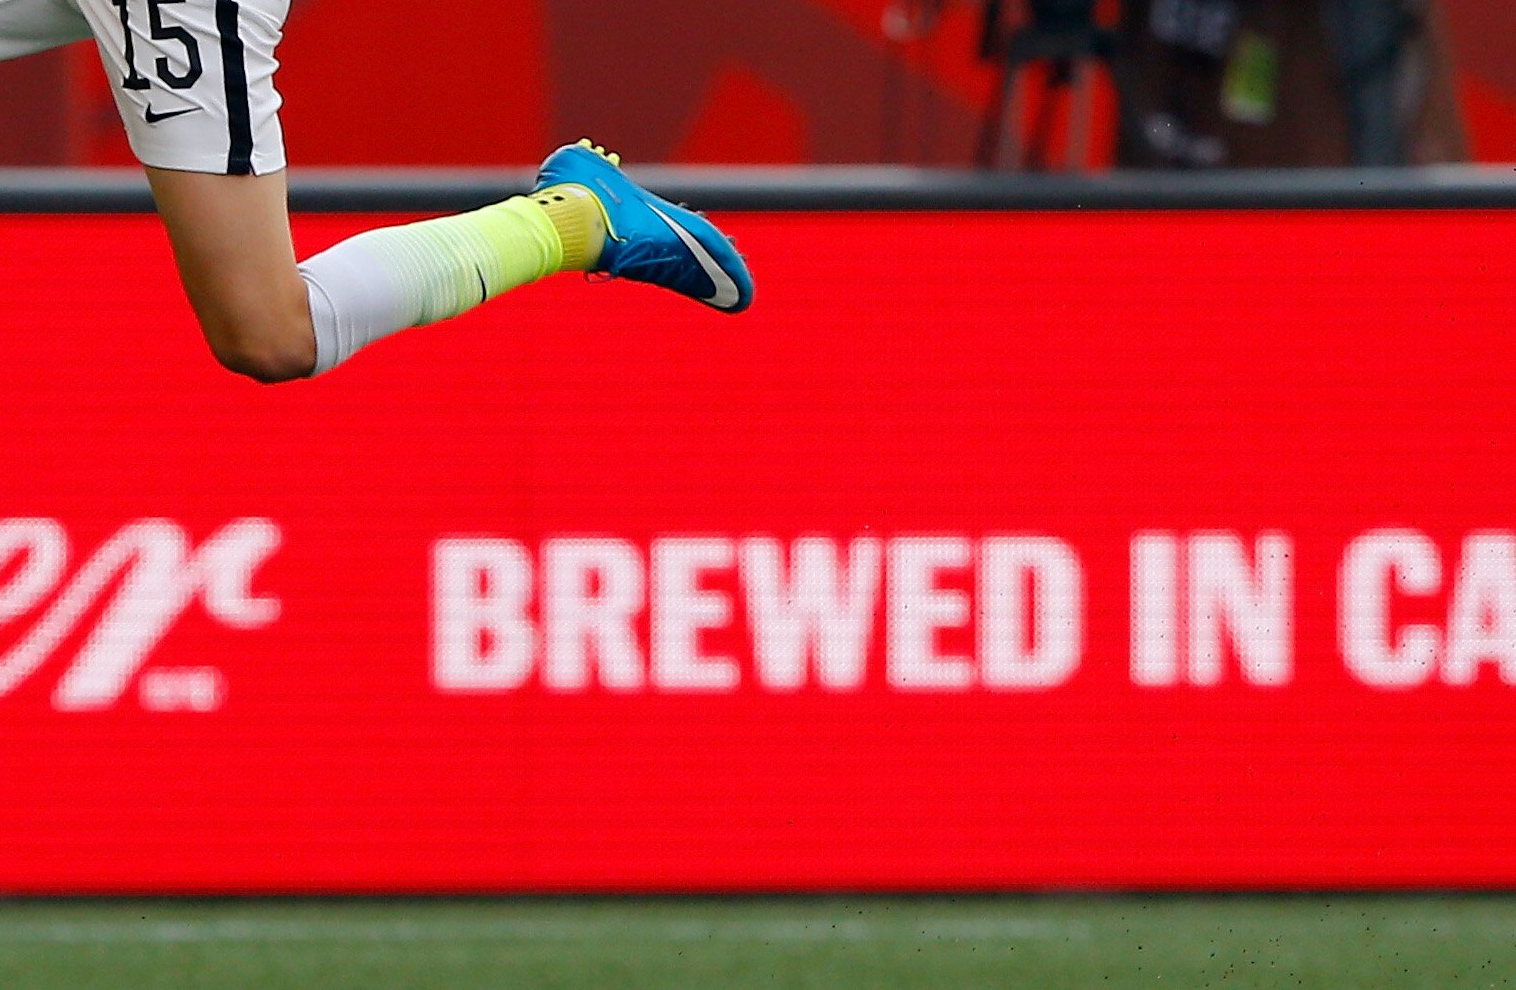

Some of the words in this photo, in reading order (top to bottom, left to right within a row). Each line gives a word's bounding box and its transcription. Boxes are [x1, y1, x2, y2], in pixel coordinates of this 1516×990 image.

[433, 536, 1084, 690] BREWED
[1129, 533, 1293, 686] IN
[1339, 528, 1516, 688] CA
